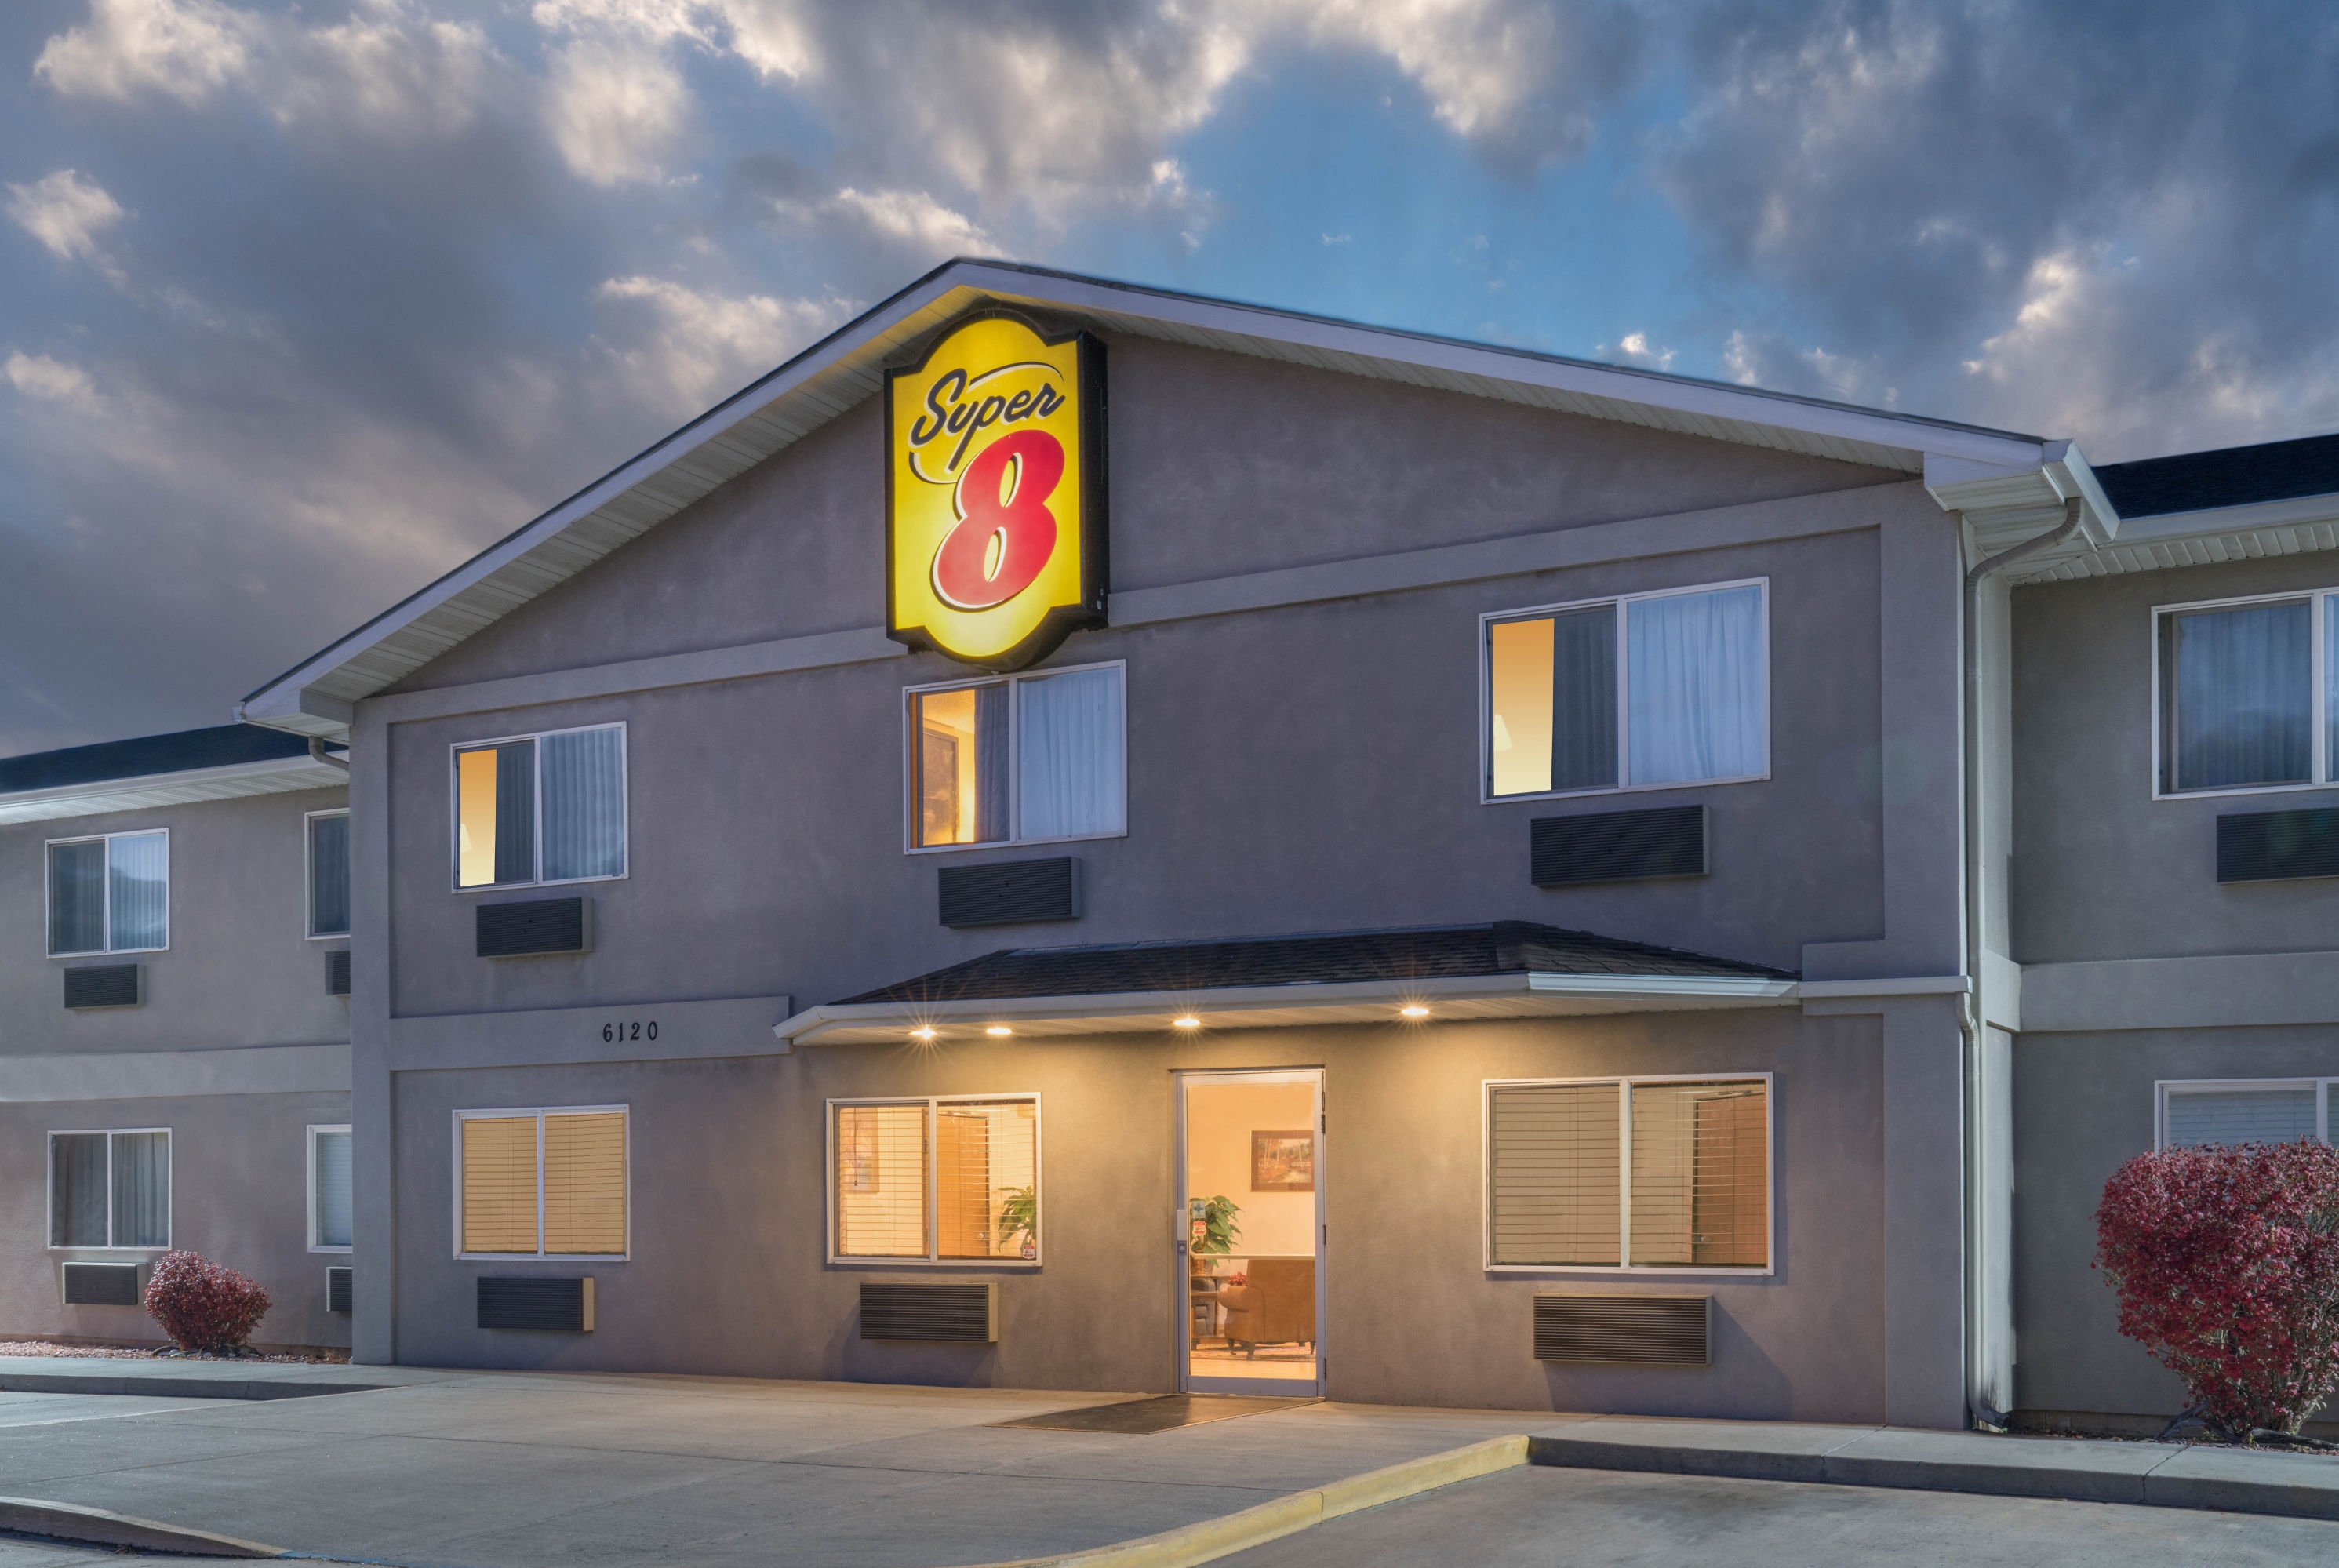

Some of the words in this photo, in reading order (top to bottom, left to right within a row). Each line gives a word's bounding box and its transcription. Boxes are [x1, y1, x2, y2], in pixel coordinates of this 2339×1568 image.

[908, 367, 1066, 475] Super
[929, 428, 1066, 613] 8
[602, 1020, 658, 1042] 6120
